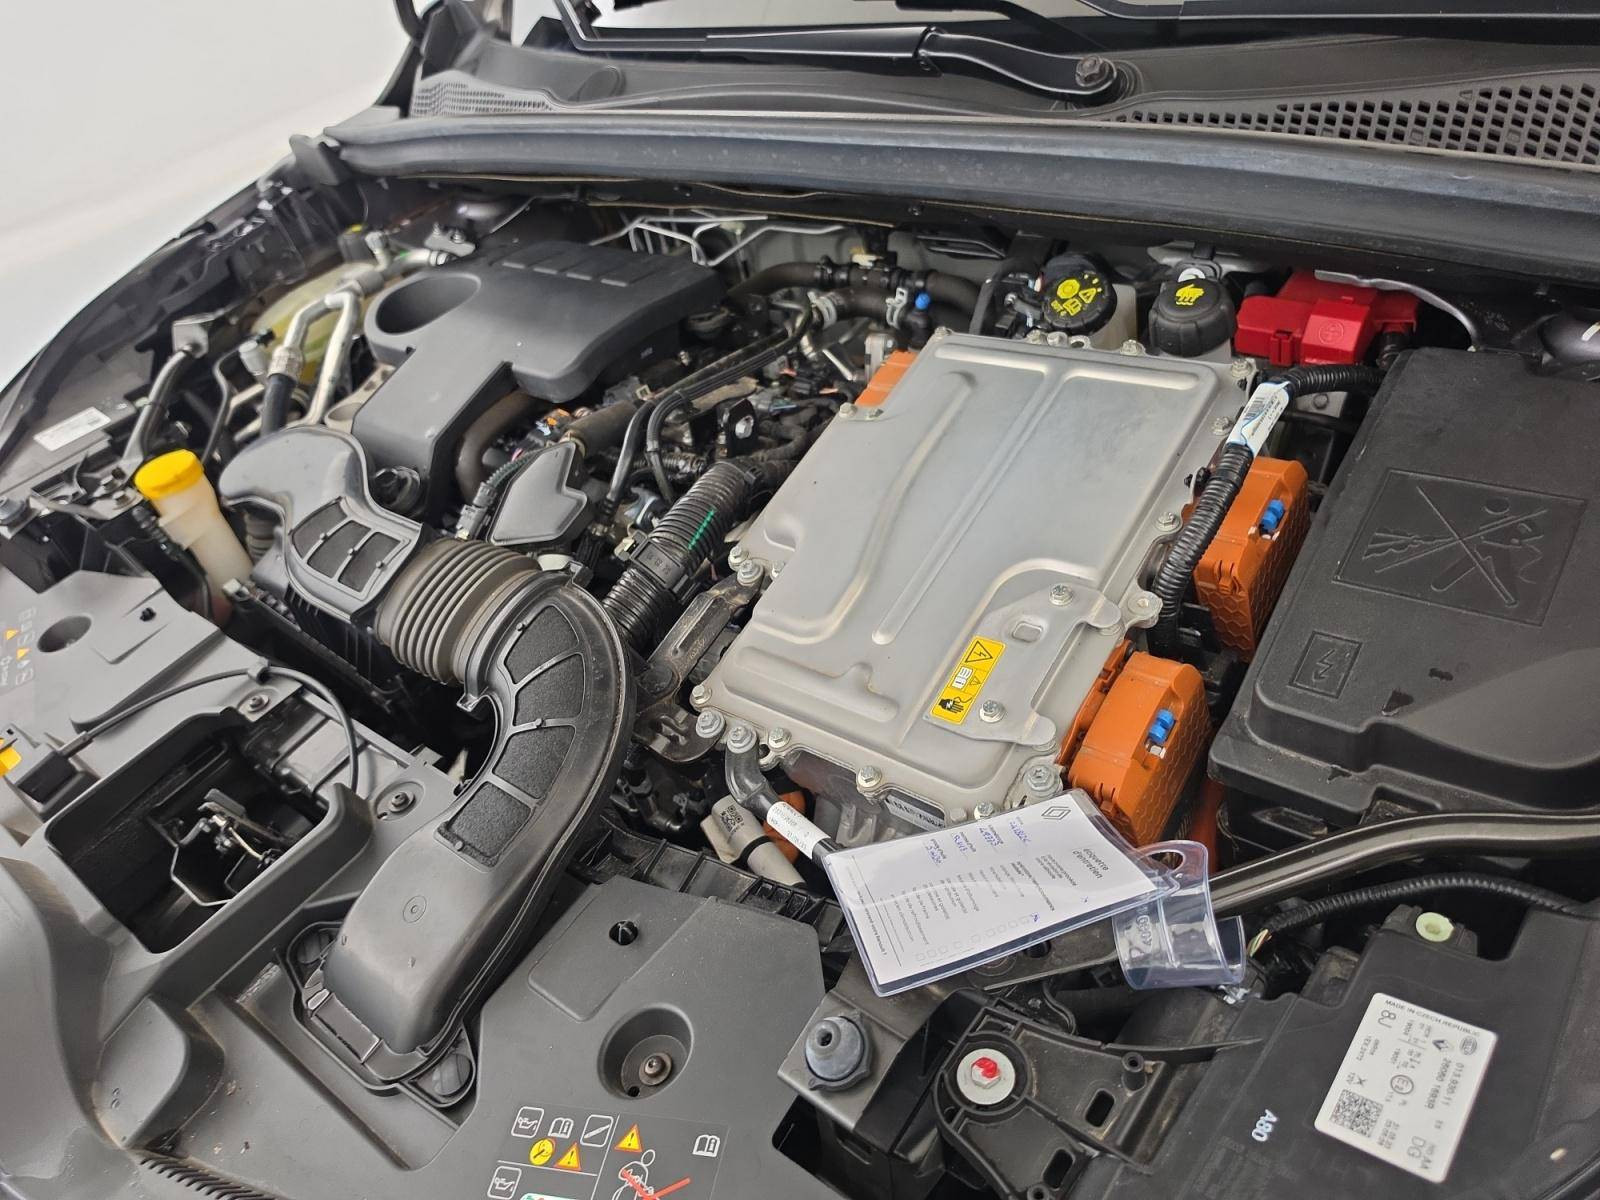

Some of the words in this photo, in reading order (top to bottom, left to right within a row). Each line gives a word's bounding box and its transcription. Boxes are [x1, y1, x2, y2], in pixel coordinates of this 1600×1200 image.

[1384, 999, 1405, 1010] MADE
[1376, 1008, 1398, 1029] 8J
[1252, 1109, 1277, 1141] A80
[1405, 1134, 1427, 1160] DG
